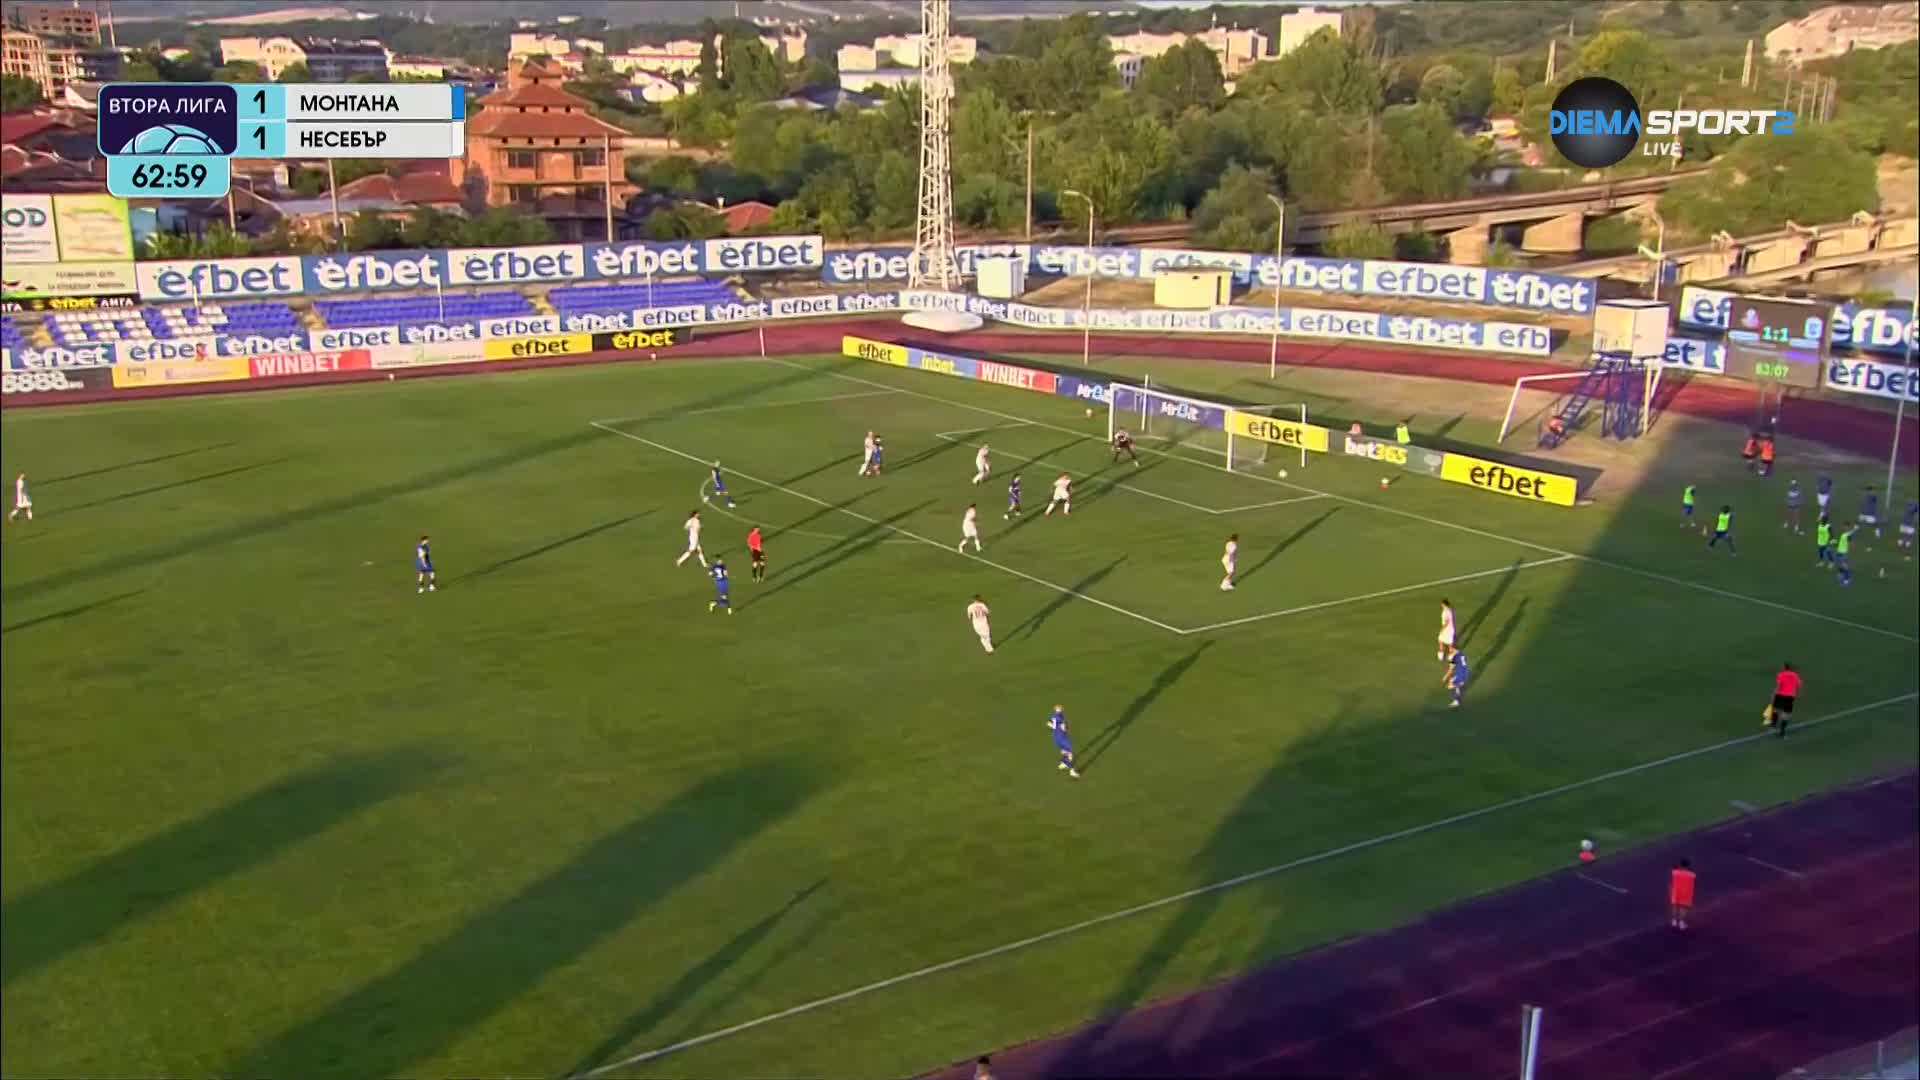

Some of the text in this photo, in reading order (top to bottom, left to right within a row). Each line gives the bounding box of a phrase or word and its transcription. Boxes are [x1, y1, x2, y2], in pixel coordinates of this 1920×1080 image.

[464, 250, 574, 281] efbet
[595, 245, 699, 277] efbet
[719, 240, 813, 269] efbet
[156, 261, 290, 296] efbet
[314, 252, 440, 289] efbet
[1258, 258, 1360, 291] efbet
[1376, 267, 1477, 297] efbet
[1491, 273, 1589, 312] efbet
[321, 330, 391, 348] efbet
[490, 319, 551, 336] efbet
[611, 328, 675, 349] efbet
[1299, 313, 1374, 336] efbet
[1386, 315, 1478, 344] efbet
[130, 343, 195, 361] efbe
[511, 339, 570, 356] efbet
[256, 353, 341, 375] WINBET
[981, 361, 1036, 388] WINBET
[1248, 420, 1304, 445] efbet
[1469, 464, 1548, 500] efbet
